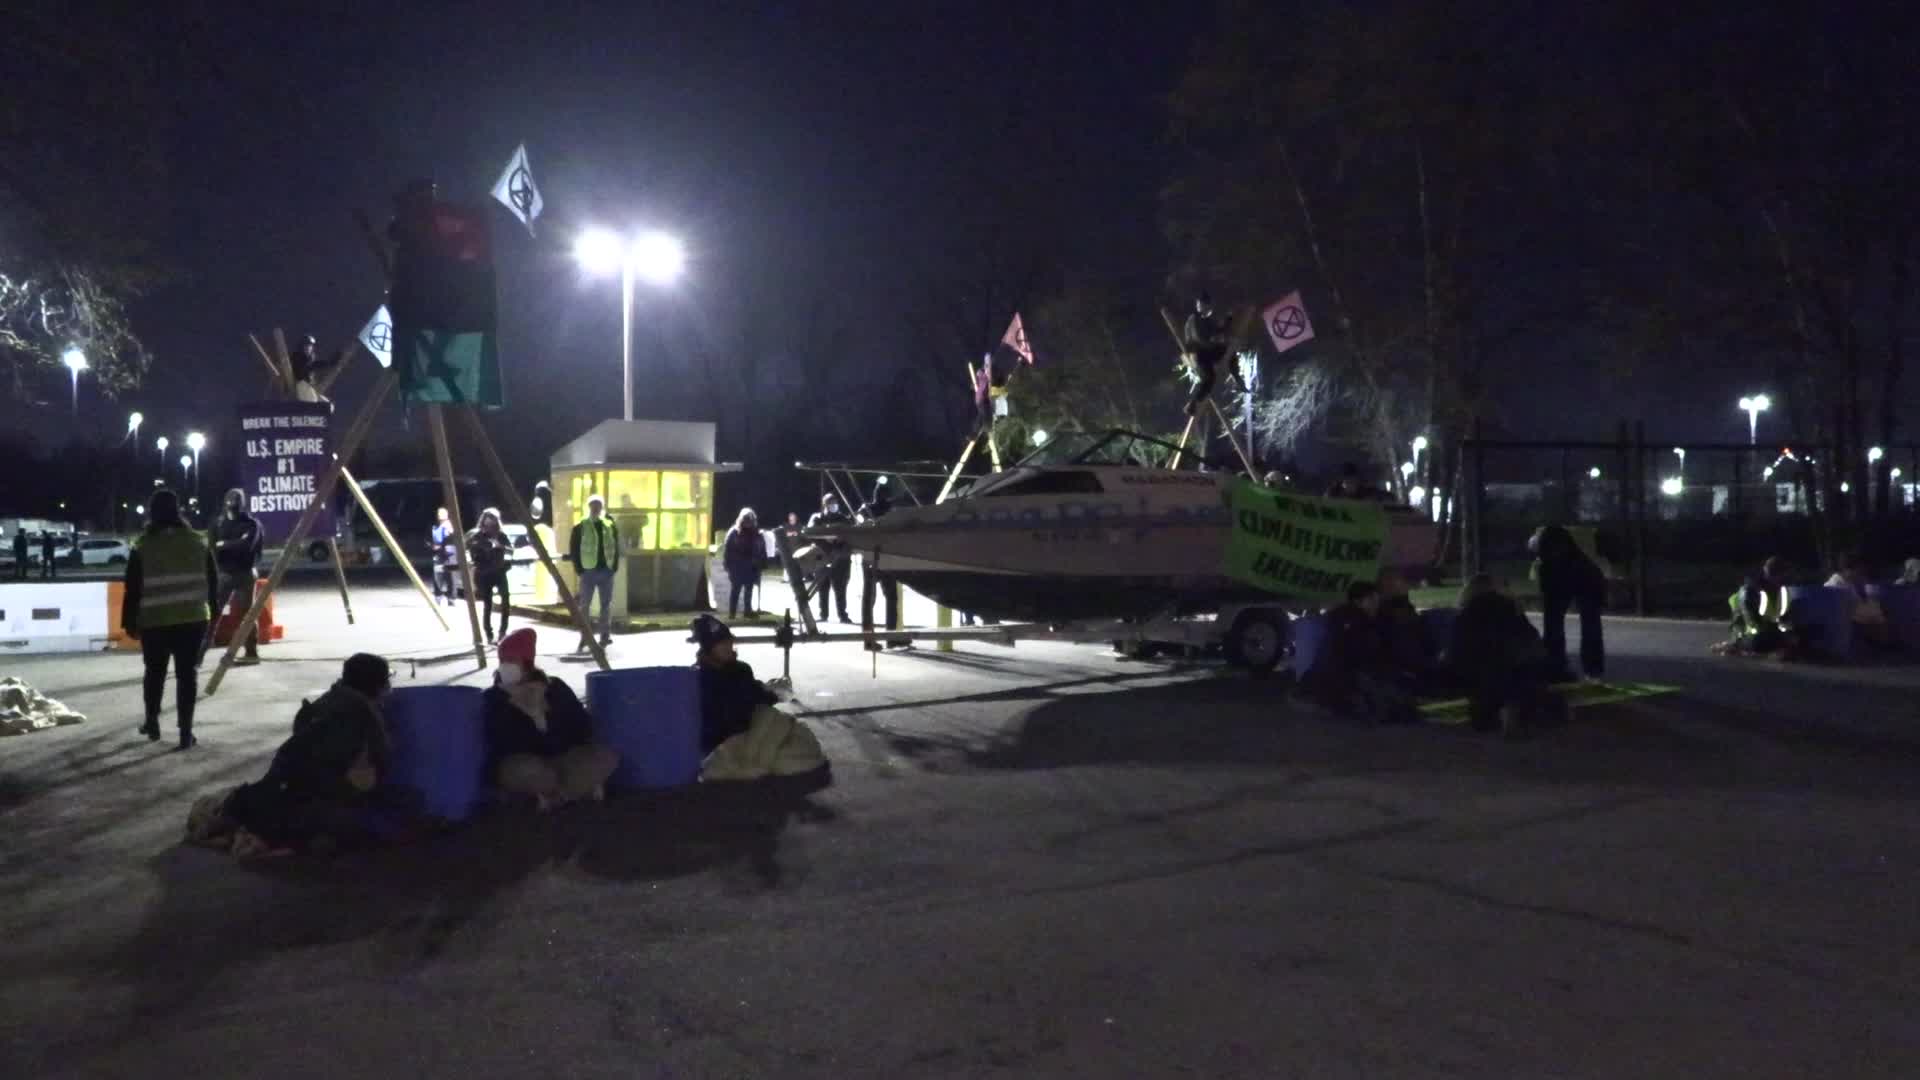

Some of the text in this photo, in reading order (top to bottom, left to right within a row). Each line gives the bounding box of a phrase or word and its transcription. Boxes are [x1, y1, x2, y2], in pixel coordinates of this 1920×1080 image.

[242, 417, 271, 430] BREAK
[273, 416, 289, 429] THE
[275, 438, 324, 455] EMPIRE
[277, 457, 296, 474] #1
[258, 475, 315, 493] CLIMATE
[250, 493, 326, 513] DESTROY
